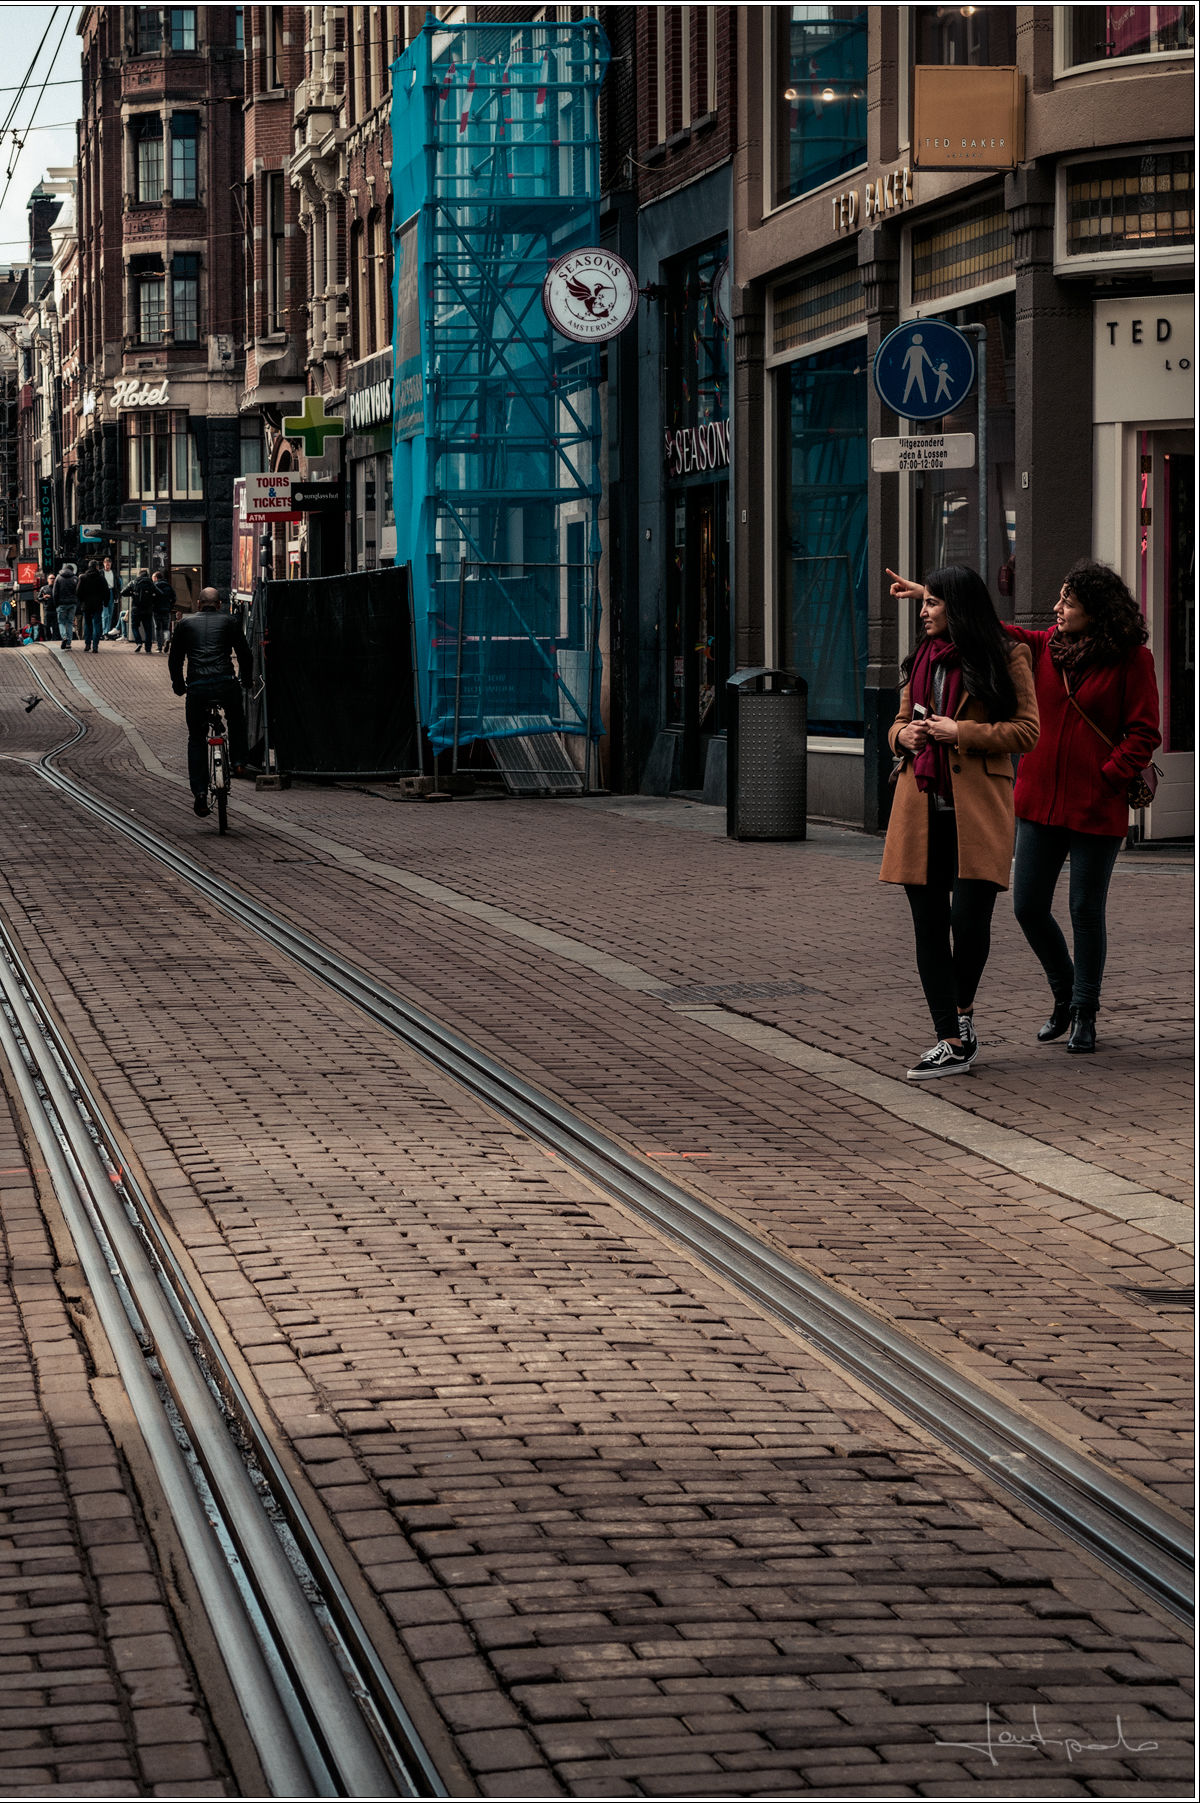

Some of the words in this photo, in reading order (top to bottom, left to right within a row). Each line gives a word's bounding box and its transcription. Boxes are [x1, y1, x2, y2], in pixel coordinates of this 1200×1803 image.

[925, 138, 950, 148] TED
[961, 138, 1006, 148] BAKER
[831, 190, 859, 231] TED
[865, 167, 914, 218] BAKER
[558, 255, 621, 280] SEASONS
[567, 315, 619, 333] AMSTERDAM
[1106, 318, 1172, 346] TED
[109, 378, 170, 408] Hotel
[256, 476, 290, 488] TOURS
[268, 487, 277, 498] &
[248, 514, 266, 522] ATM
